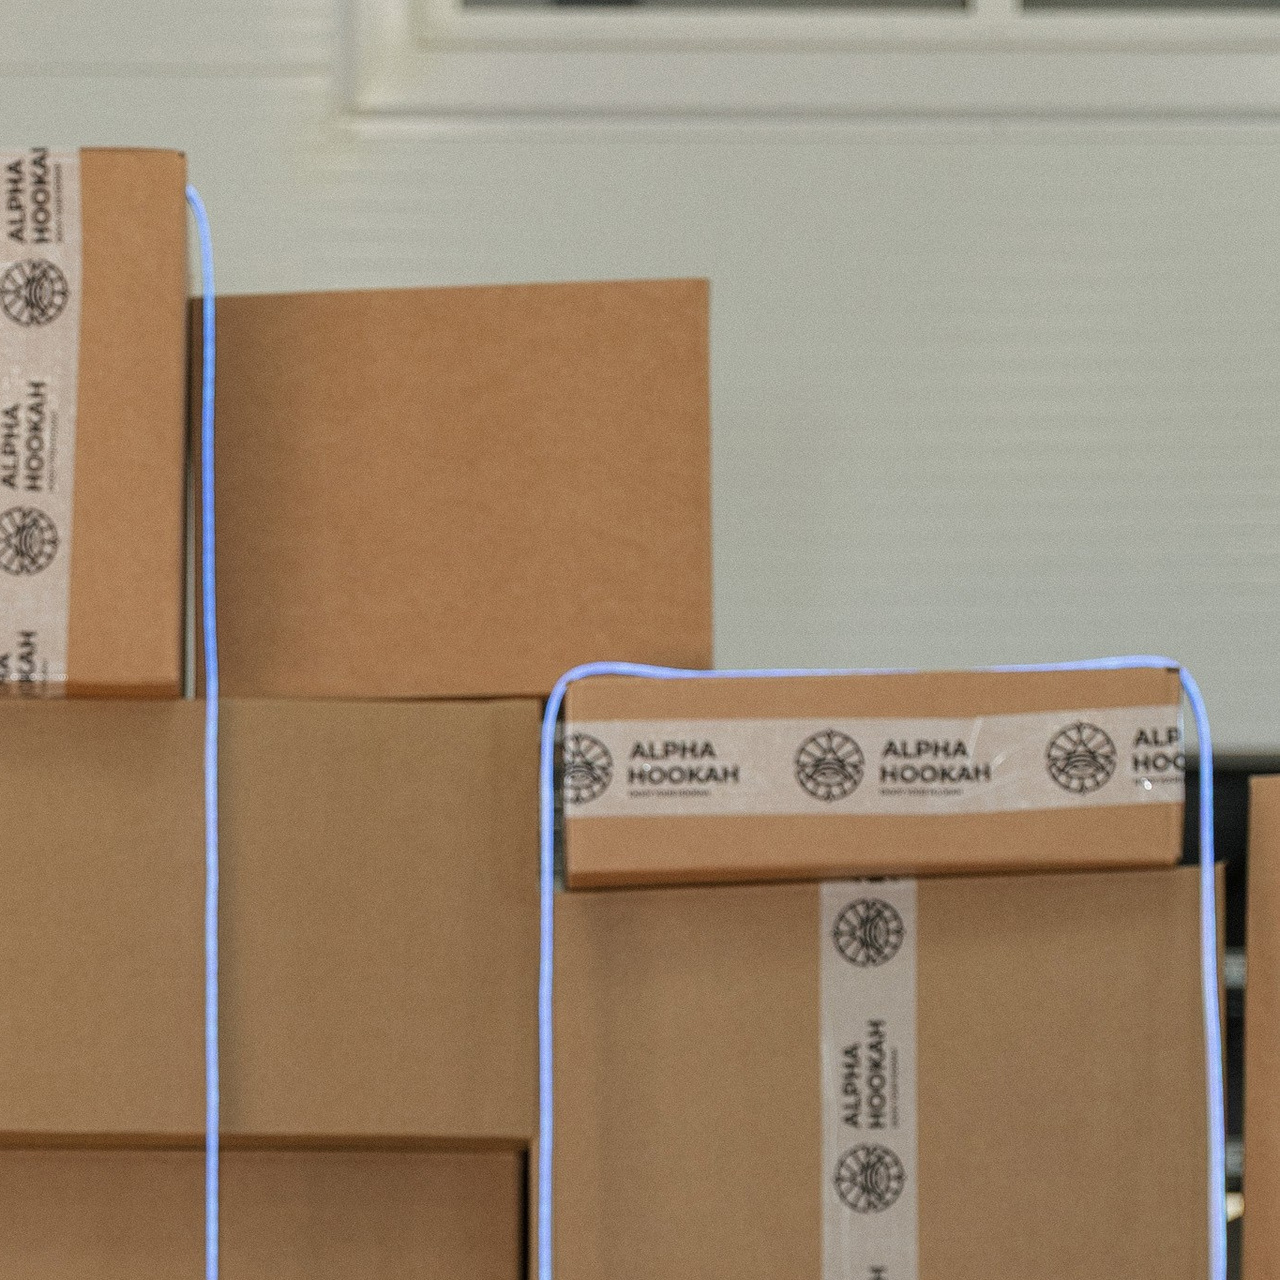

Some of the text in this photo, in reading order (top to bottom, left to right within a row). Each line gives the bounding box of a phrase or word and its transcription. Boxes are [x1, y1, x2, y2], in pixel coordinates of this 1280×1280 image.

[7, 158, 25, 244] ALPHA
[0, 401, 21, 490] ALPHA
[26, 380, 48, 493] HOOKAH
[628, 764, 740, 785] HOOKAH
[629, 740, 717, 761] ALPHA
[880, 762, 991, 785] HOOKAH
[882, 738, 969, 760] ALPHA
[844, 1042, 860, 1130] ALPHA
[868, 1019, 886, 1130] HOOKAH
